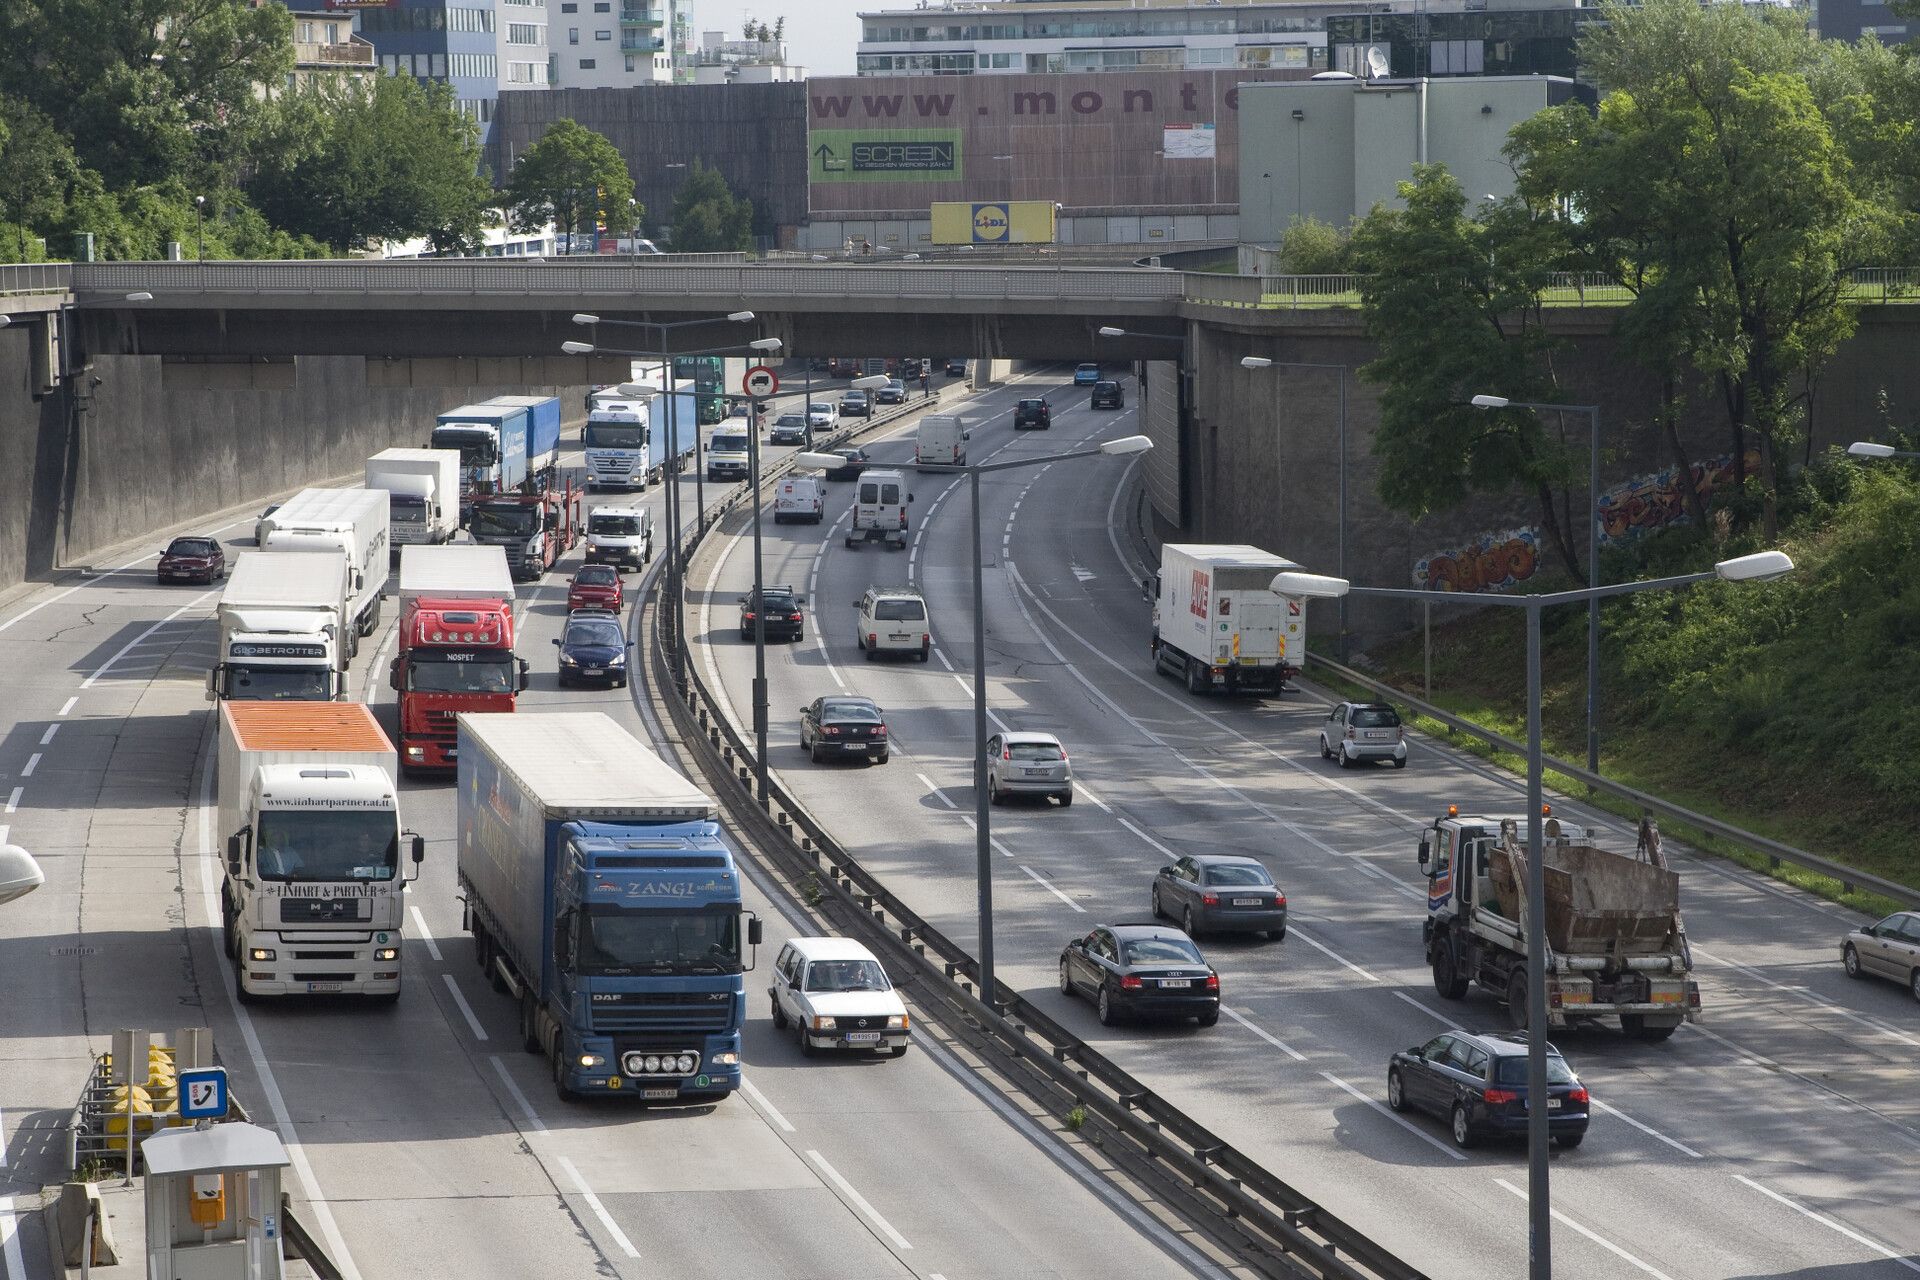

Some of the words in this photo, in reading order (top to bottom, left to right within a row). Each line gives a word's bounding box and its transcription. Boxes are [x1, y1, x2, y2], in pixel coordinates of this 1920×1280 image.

[233, 646, 323, 656] GLOBETROTTER
[446, 653, 475, 662] NOSPET
[277, 885, 320, 898] LINHART
[322, 886, 331, 898] &
[333, 886, 378, 898] PARTNER
[627, 883, 695, 897] ZANGL
